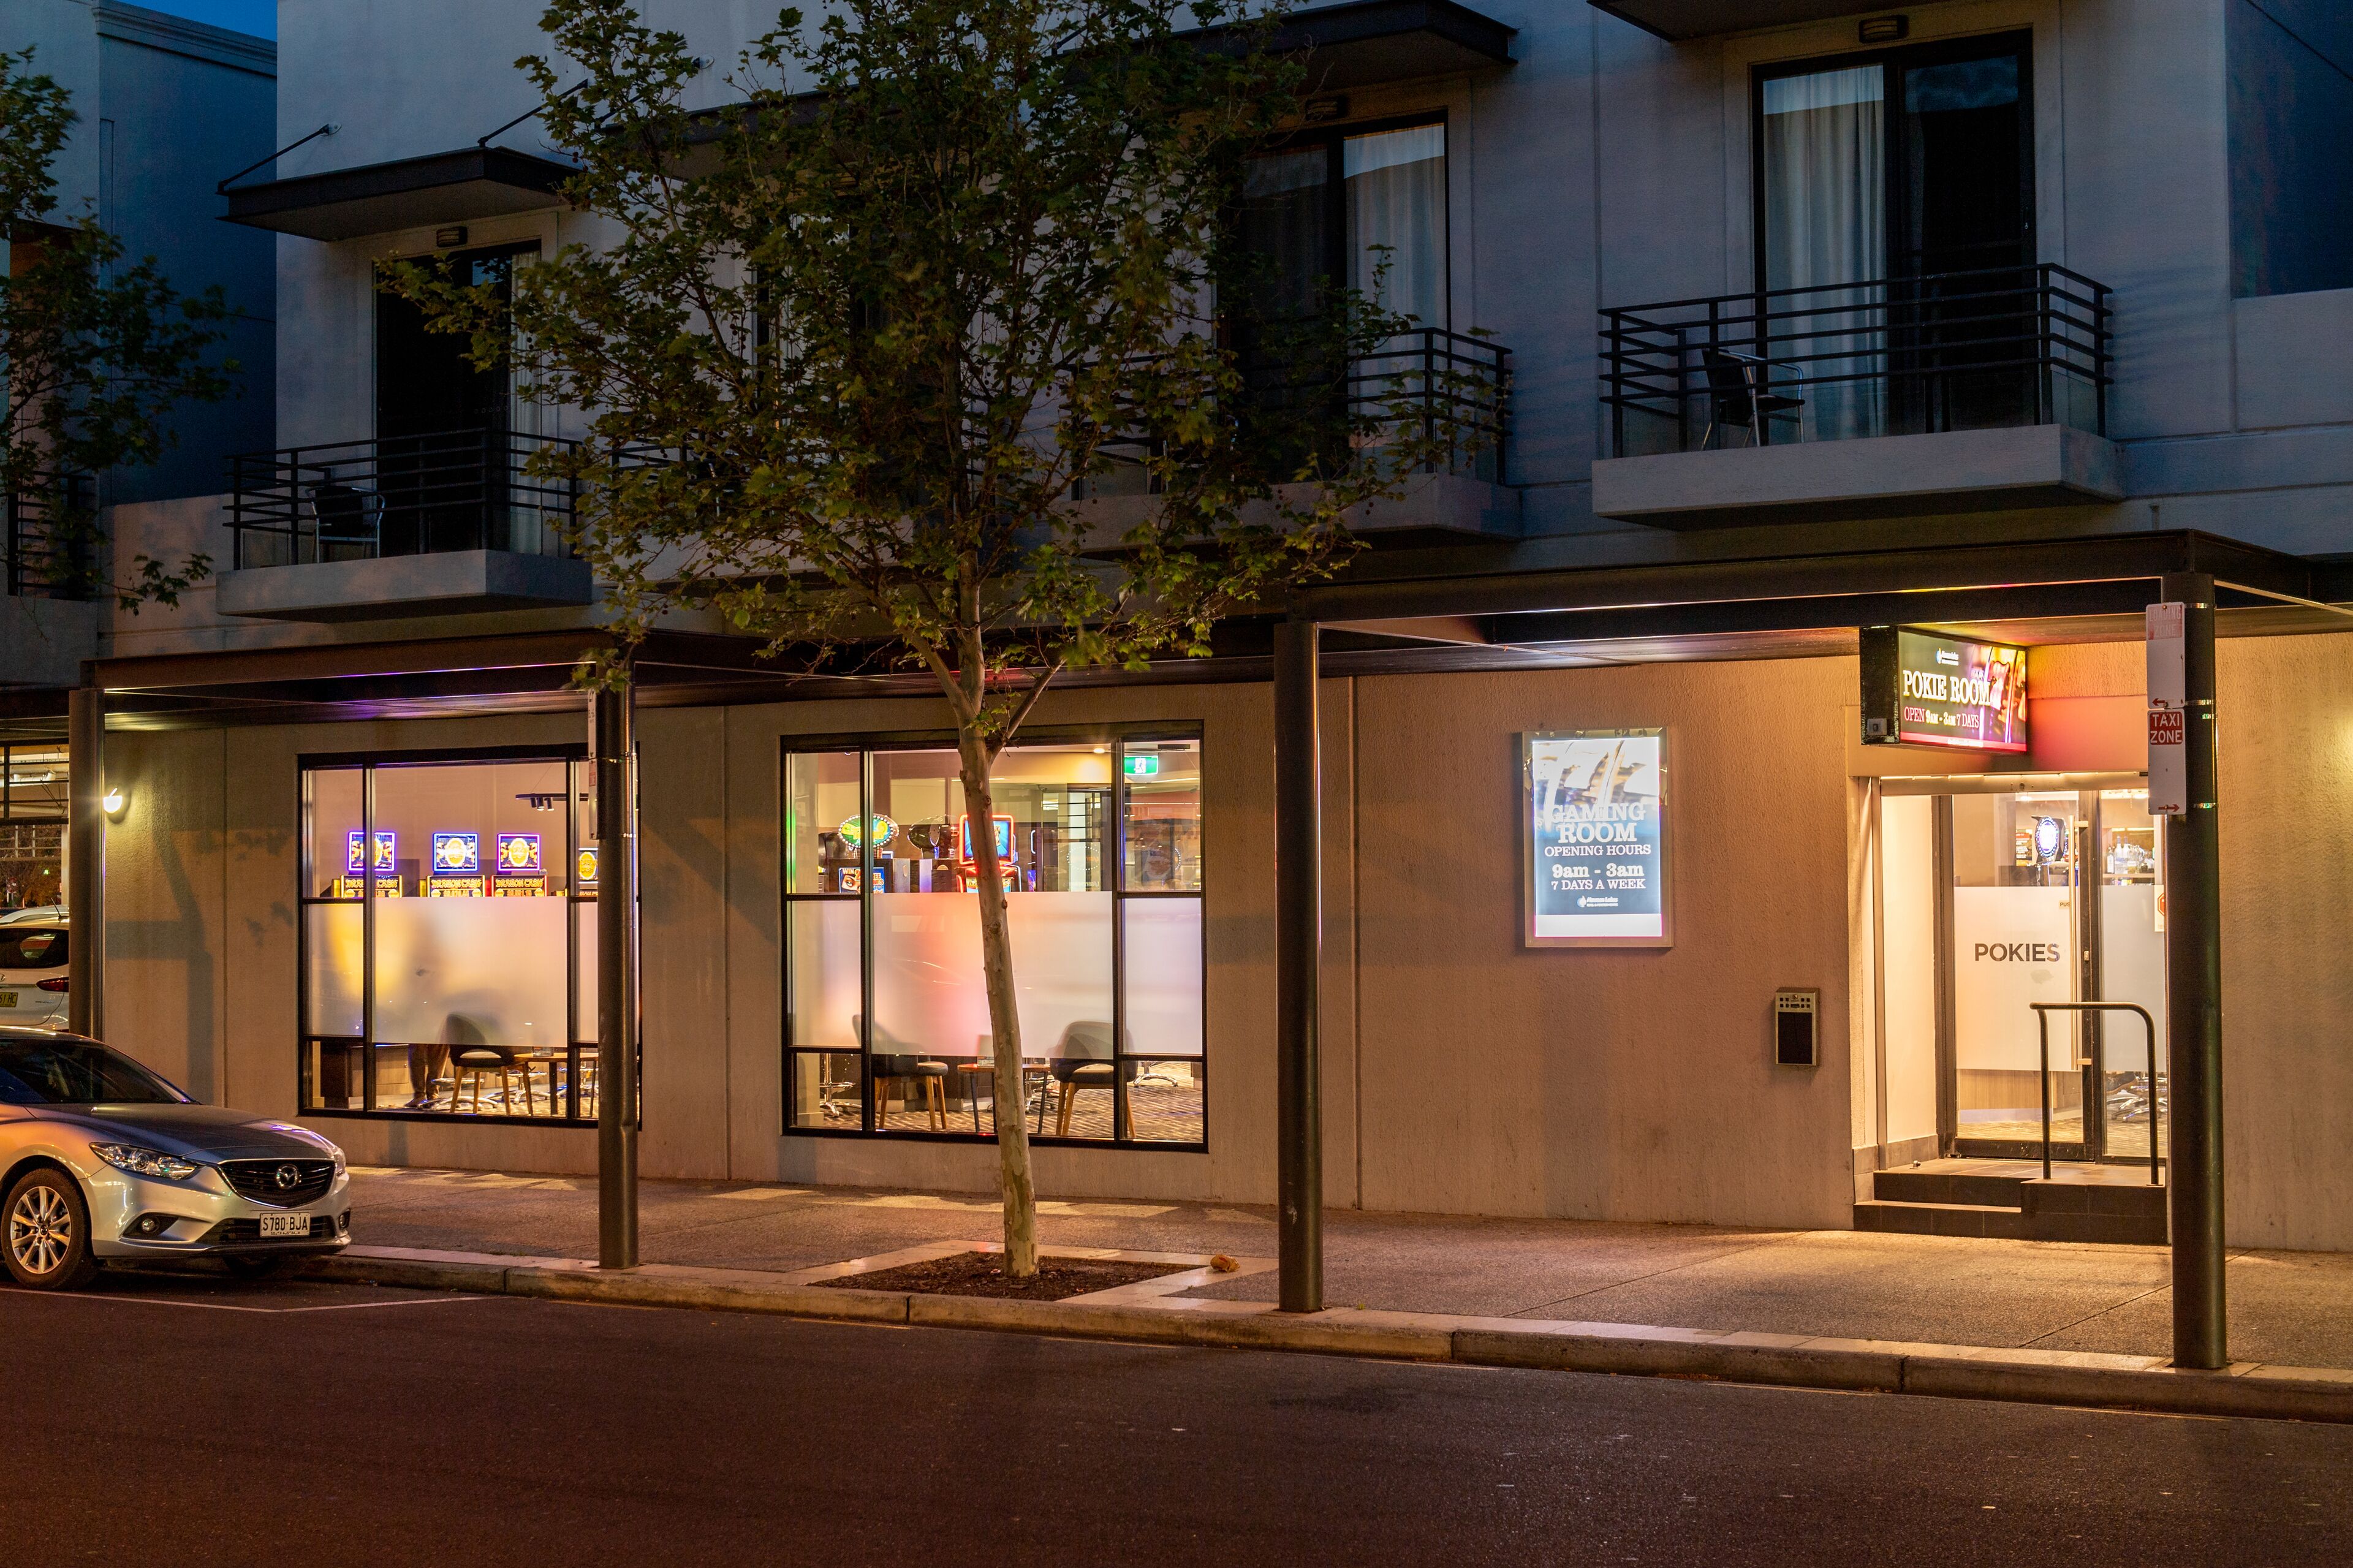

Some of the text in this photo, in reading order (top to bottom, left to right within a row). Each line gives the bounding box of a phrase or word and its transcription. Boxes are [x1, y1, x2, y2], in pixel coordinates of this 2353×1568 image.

[2154, 624, 2177, 637] ZONE
[1903, 670, 1991, 706] POKIE ROOM
[1904, 706, 1925, 722] OPEN
[1957, 713, 1961, 726] 7
[1961, 713, 1979, 729] DAYS
[2153, 713, 2180, 727] TAXI
[2150, 730, 2182, 743] ZONE
[1551, 802, 1646, 824] GAMING
[1558, 822, 1637, 844] ROOM
[1544, 844, 1651, 857] OPENING HOURS
[1552, 864, 1590, 878] 9am
[1606, 863, 1644, 877] 3am
[1551, 878, 1646, 890] 7 DAYS A WEEK
[1975, 943, 2060, 962] POKIES
[263, 1217, 308, 1230] S780-BJA
